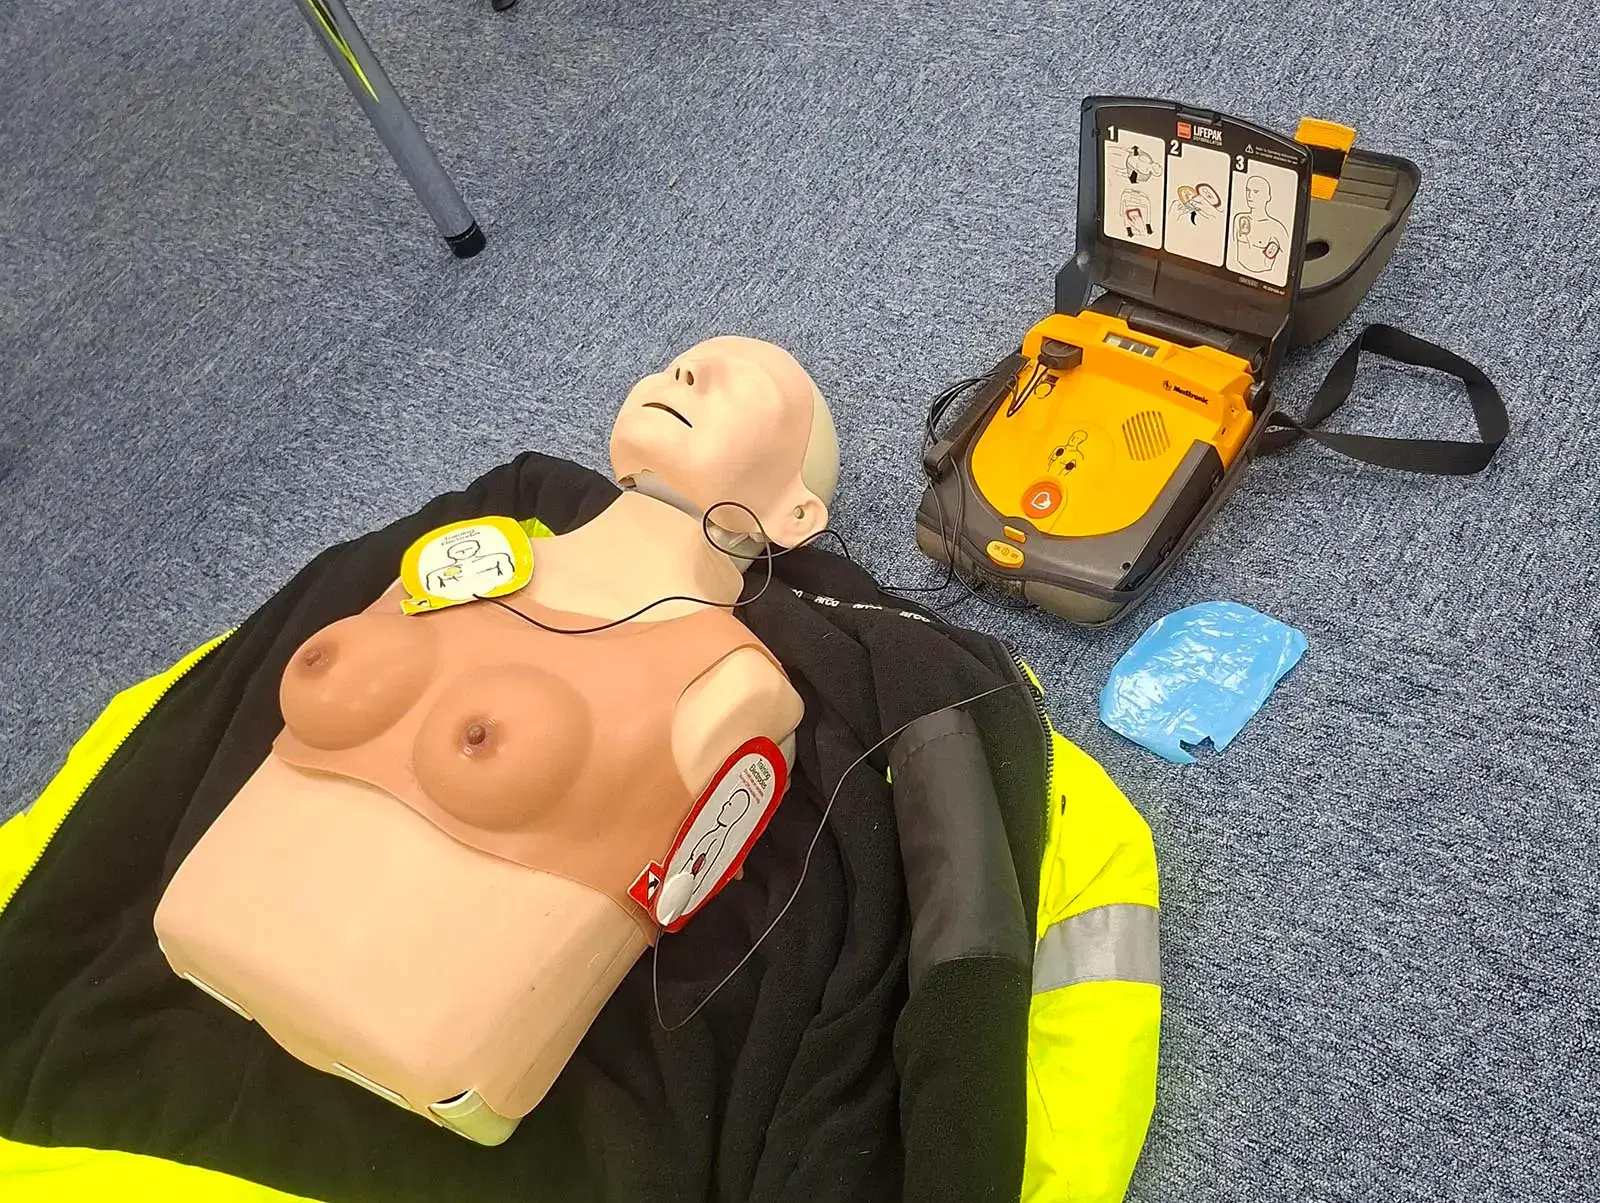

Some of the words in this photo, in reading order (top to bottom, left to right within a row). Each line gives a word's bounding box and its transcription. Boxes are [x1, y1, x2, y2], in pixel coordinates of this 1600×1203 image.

[1107, 125, 1115, 140] 1
[1193, 125, 1222, 141] LIFEPAK
[1170, 139, 1179, 155] 2
[1235, 155, 1245, 171] 3
[1173, 385, 1208, 404] Medtronic
[814, 595, 840, 607] arco
[899, 610, 931, 623] arco
